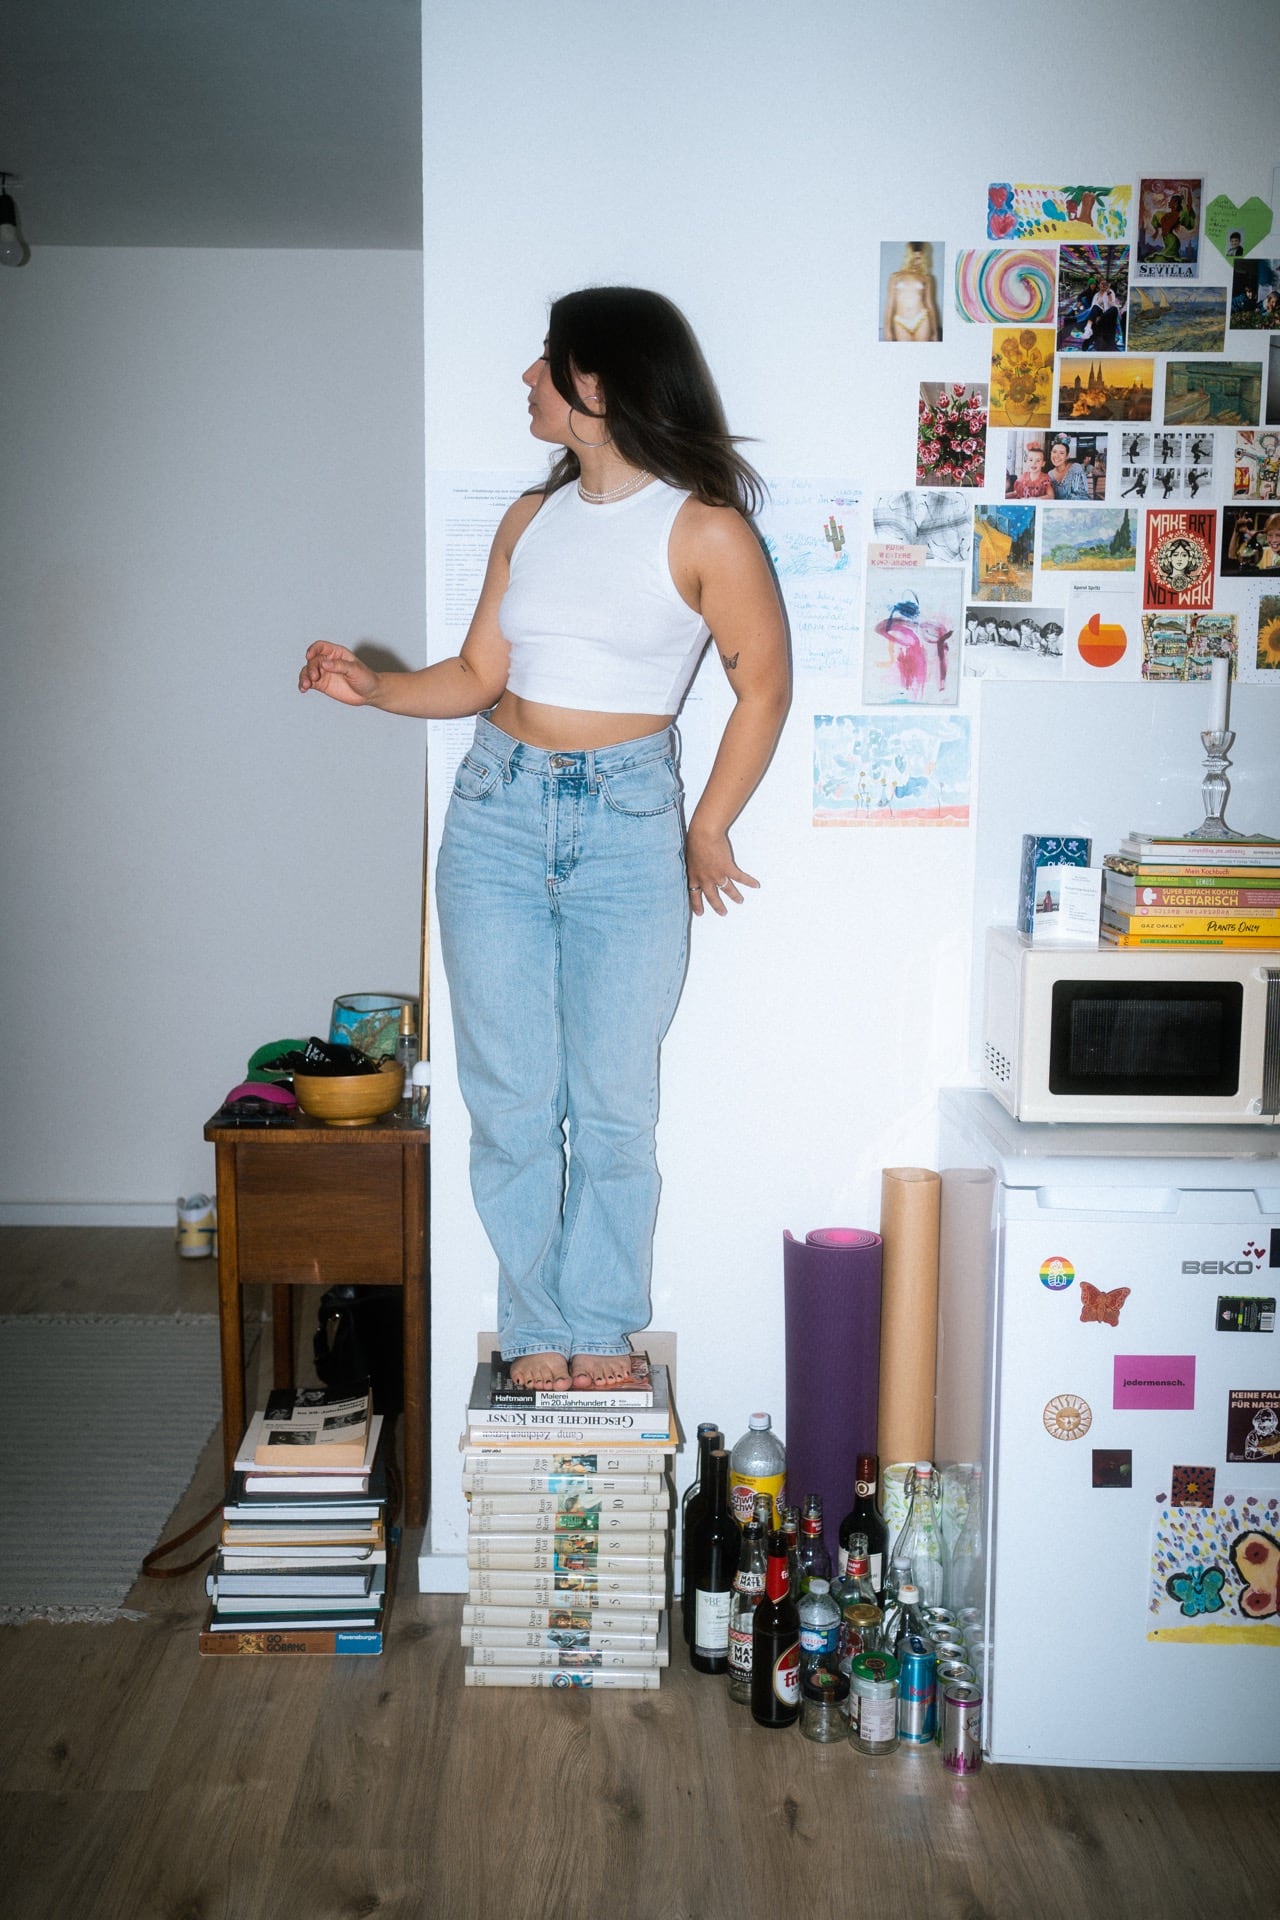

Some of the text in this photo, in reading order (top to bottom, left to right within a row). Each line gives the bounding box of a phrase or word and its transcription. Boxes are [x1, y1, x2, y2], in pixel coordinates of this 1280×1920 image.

[1140, 264, 1192, 274] SEVILLA
[1150, 514, 1214, 551] MAKE ART
[1146, 572, 1212, 606] NOT WAR
[1162, 896, 1239, 906] VEGETARISCH
[1182, 1261, 1253, 1274] BEKO
[1123, 1379, 1185, 1387] jedermensch.
[495, 1394, 533, 1402] Haftmann
[1231, 1400, 1250, 1408] FÜR
[487, 1413, 527, 1425] KUNST
[558, 1415, 634, 1428] GESCHICHTE
[510, 1432, 550, 1440] Zeichnen
[557, 1432, 584, 1440] Camp
[608, 1460, 619, 1469] 12
[613, 1499, 624, 1509] 10
